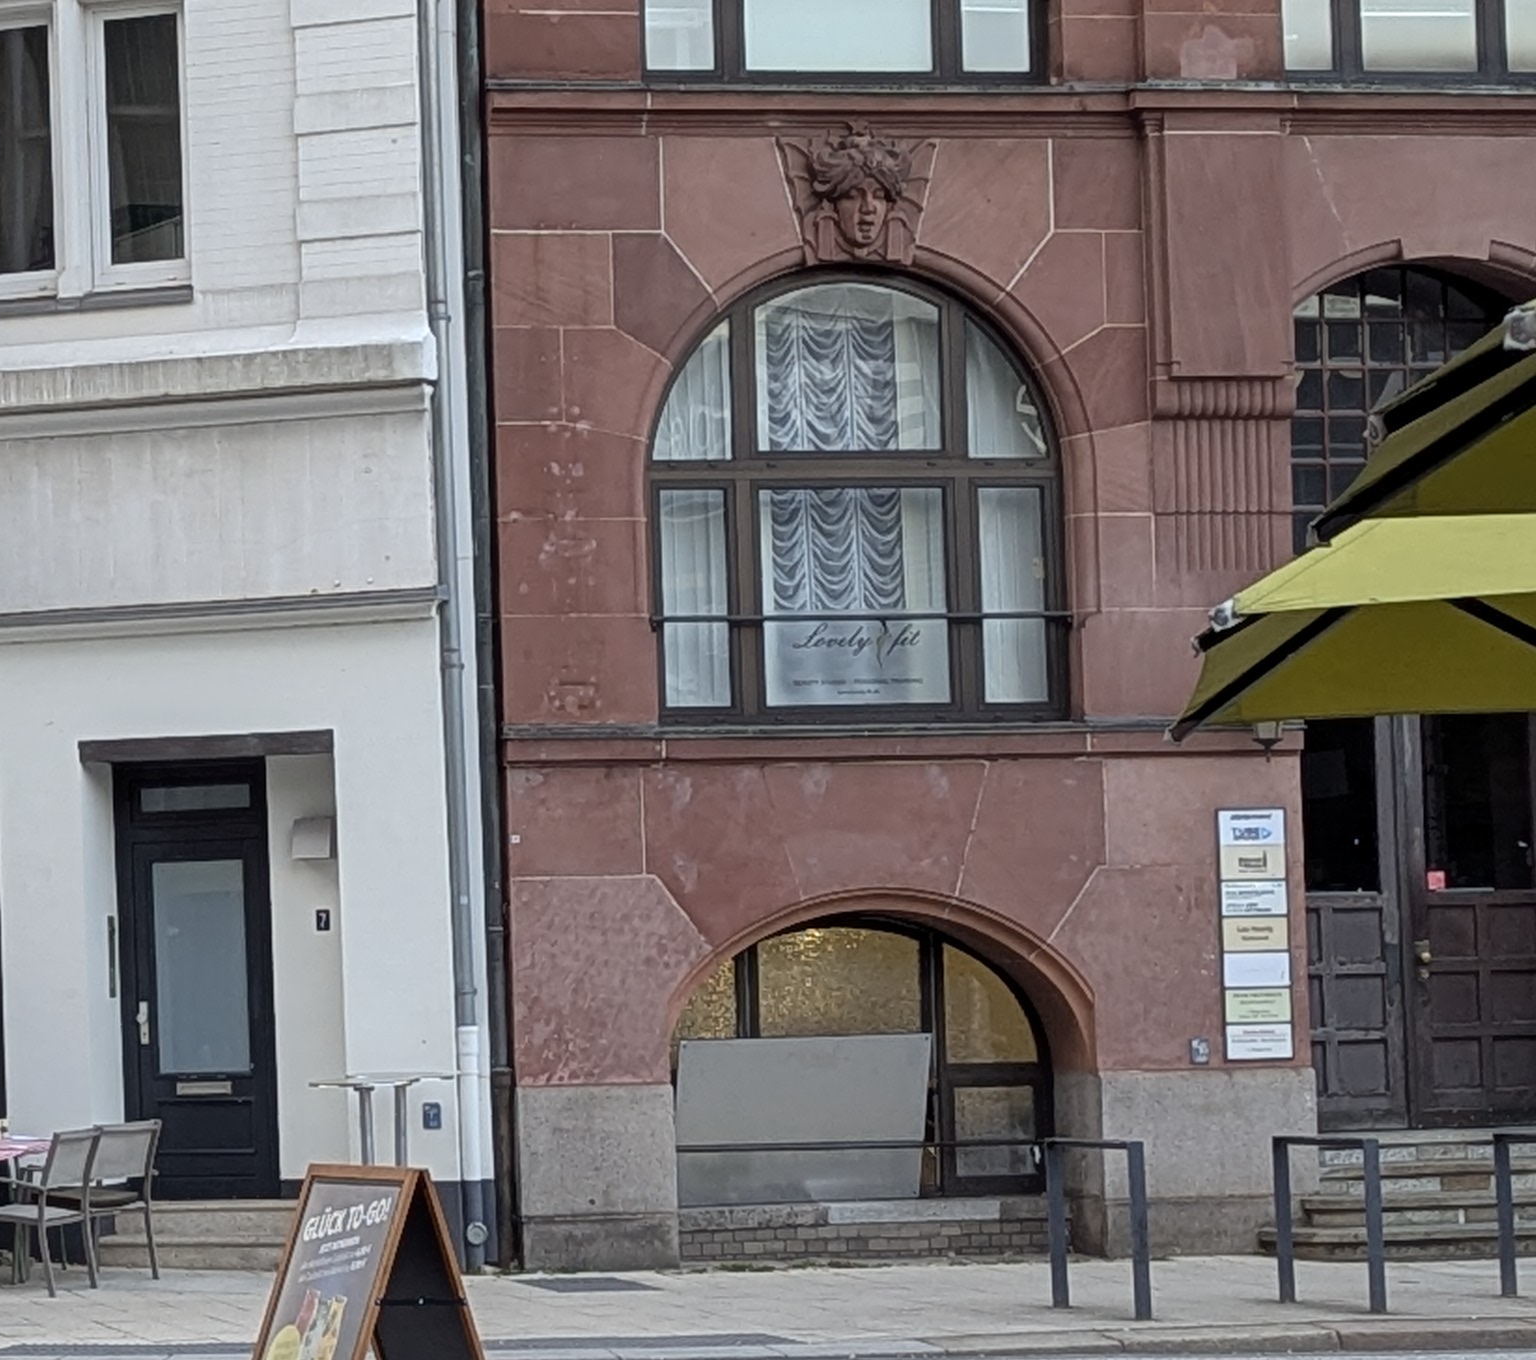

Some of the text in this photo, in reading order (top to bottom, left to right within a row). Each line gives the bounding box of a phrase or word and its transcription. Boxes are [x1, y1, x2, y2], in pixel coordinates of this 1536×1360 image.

[793, 622, 921, 656] Lovely fit
[303, 1196, 392, 1242] GLÜCK TO-GO!
